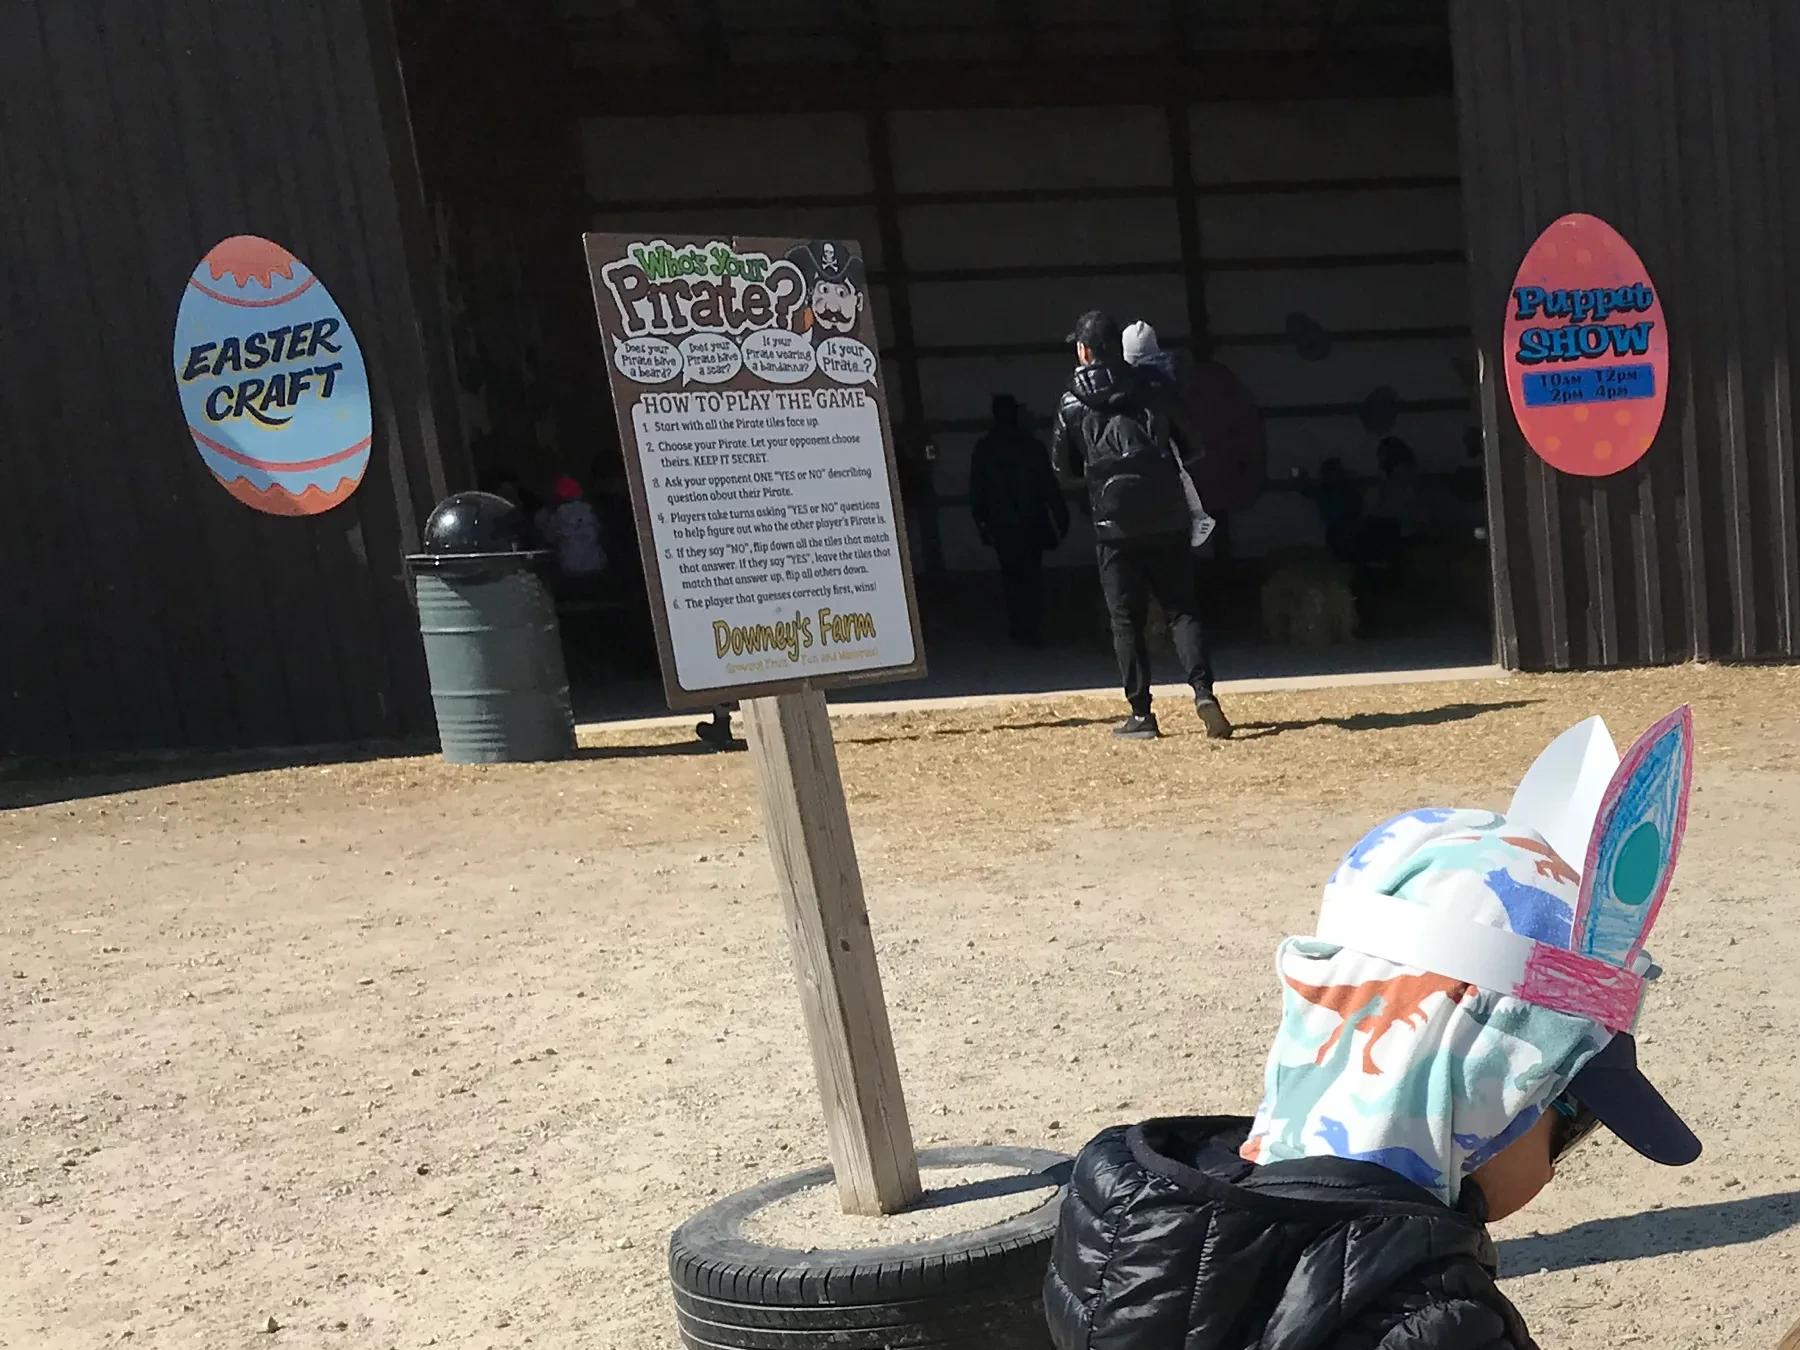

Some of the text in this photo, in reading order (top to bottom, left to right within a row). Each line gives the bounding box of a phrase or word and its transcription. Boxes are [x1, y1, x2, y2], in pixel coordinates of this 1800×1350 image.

[633, 246, 708, 281] Who's
[608, 264, 801, 329] Pirate?
[1514, 282, 1653, 322] Puppet
[183, 317, 343, 381] EASTER
[838, 344, 865, 358] your
[1516, 322, 1655, 364] SHOW
[206, 362, 343, 425] CRAFT
[642, 391, 865, 414] HOW TO PLAY THE GAME
[657, 440, 693, 452] Choose
[693, 441, 717, 453] your
[750, 437, 766, 448] Let
[766, 437, 788, 450] your
[789, 435, 831, 448] opponent
[831, 433, 860, 444] choose
[713, 610, 813, 662] Downey's
[818, 607, 877, 646] Farm
